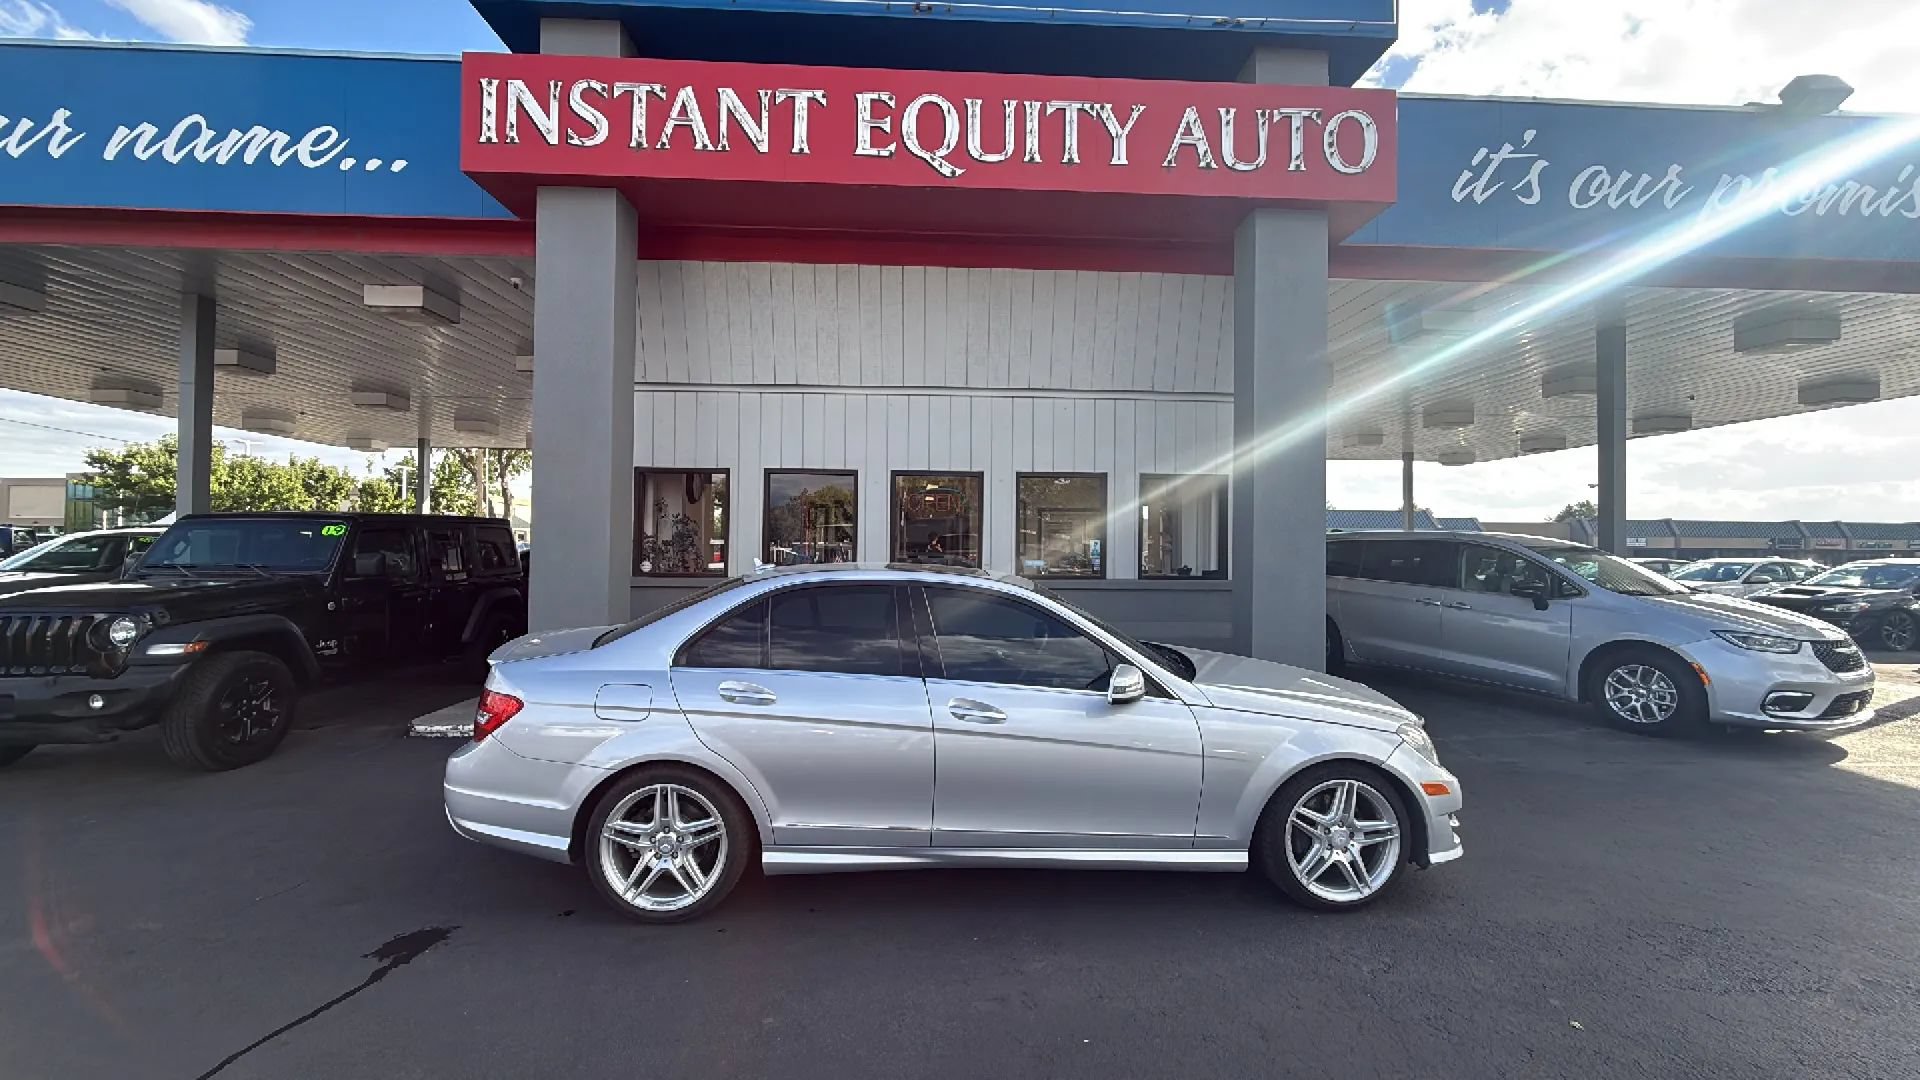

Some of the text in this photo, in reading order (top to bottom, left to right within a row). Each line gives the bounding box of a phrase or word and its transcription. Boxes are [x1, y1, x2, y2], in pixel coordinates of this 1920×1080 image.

[103, 113, 408, 173] name...
[479, 78, 1379, 178] INSTANT EQUITY AUTO
[1451, 129, 1550, 205] it's
[1569, 163, 1695, 209] our
